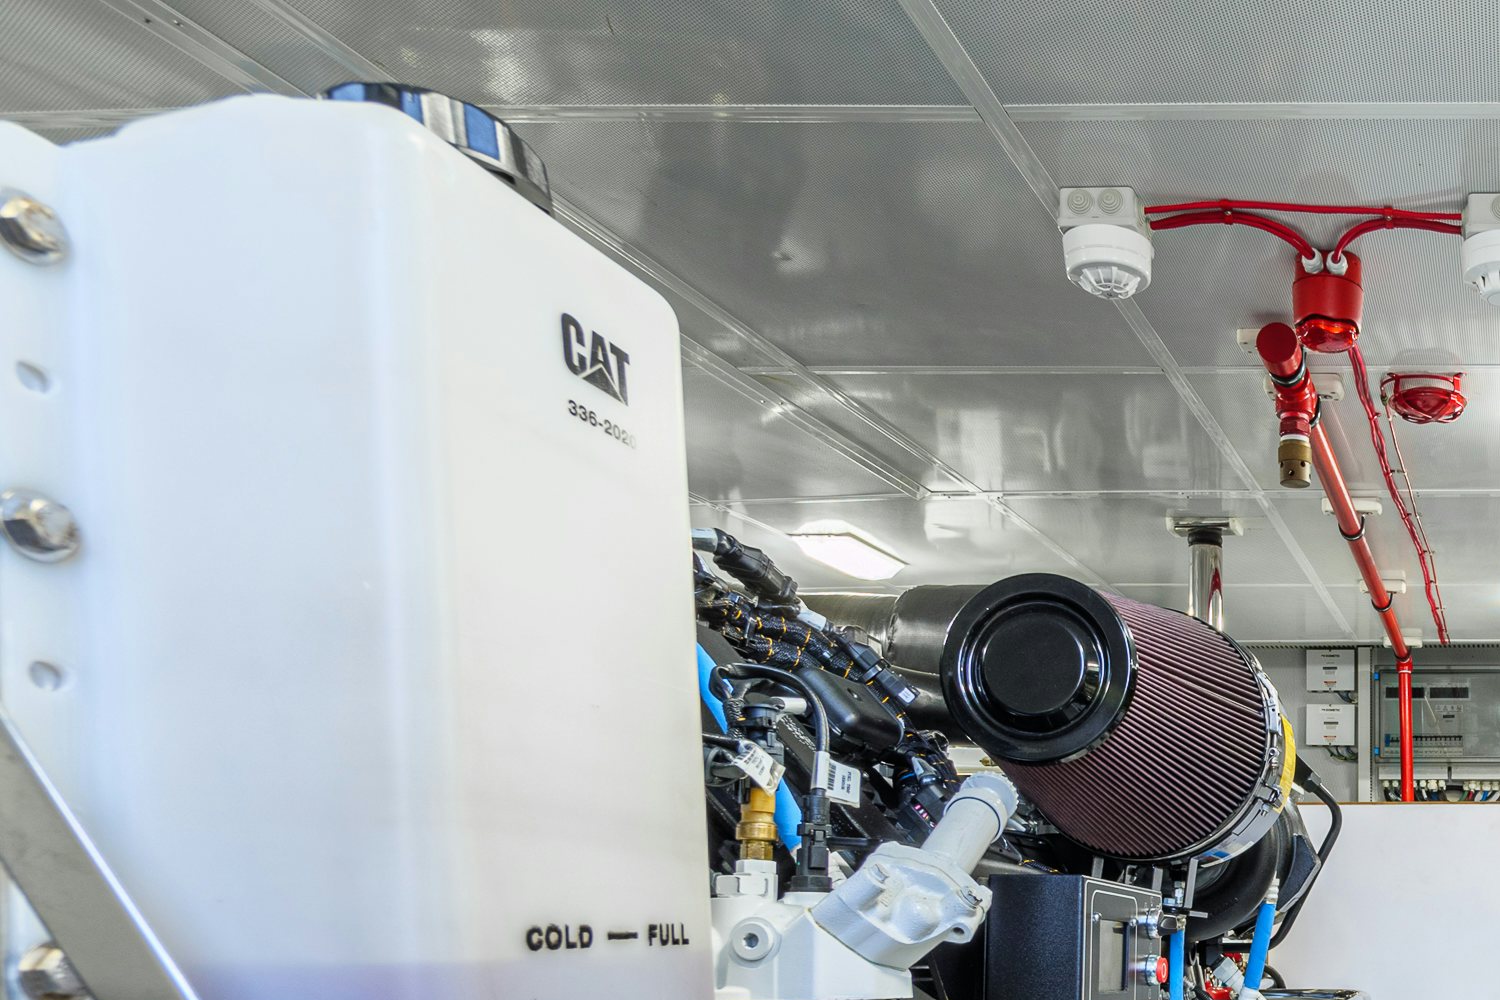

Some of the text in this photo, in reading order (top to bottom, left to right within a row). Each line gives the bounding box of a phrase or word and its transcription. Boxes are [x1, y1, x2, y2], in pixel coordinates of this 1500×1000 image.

[561, 312, 631, 407] CAT
[526, 922, 690, 951] COLD FULL
